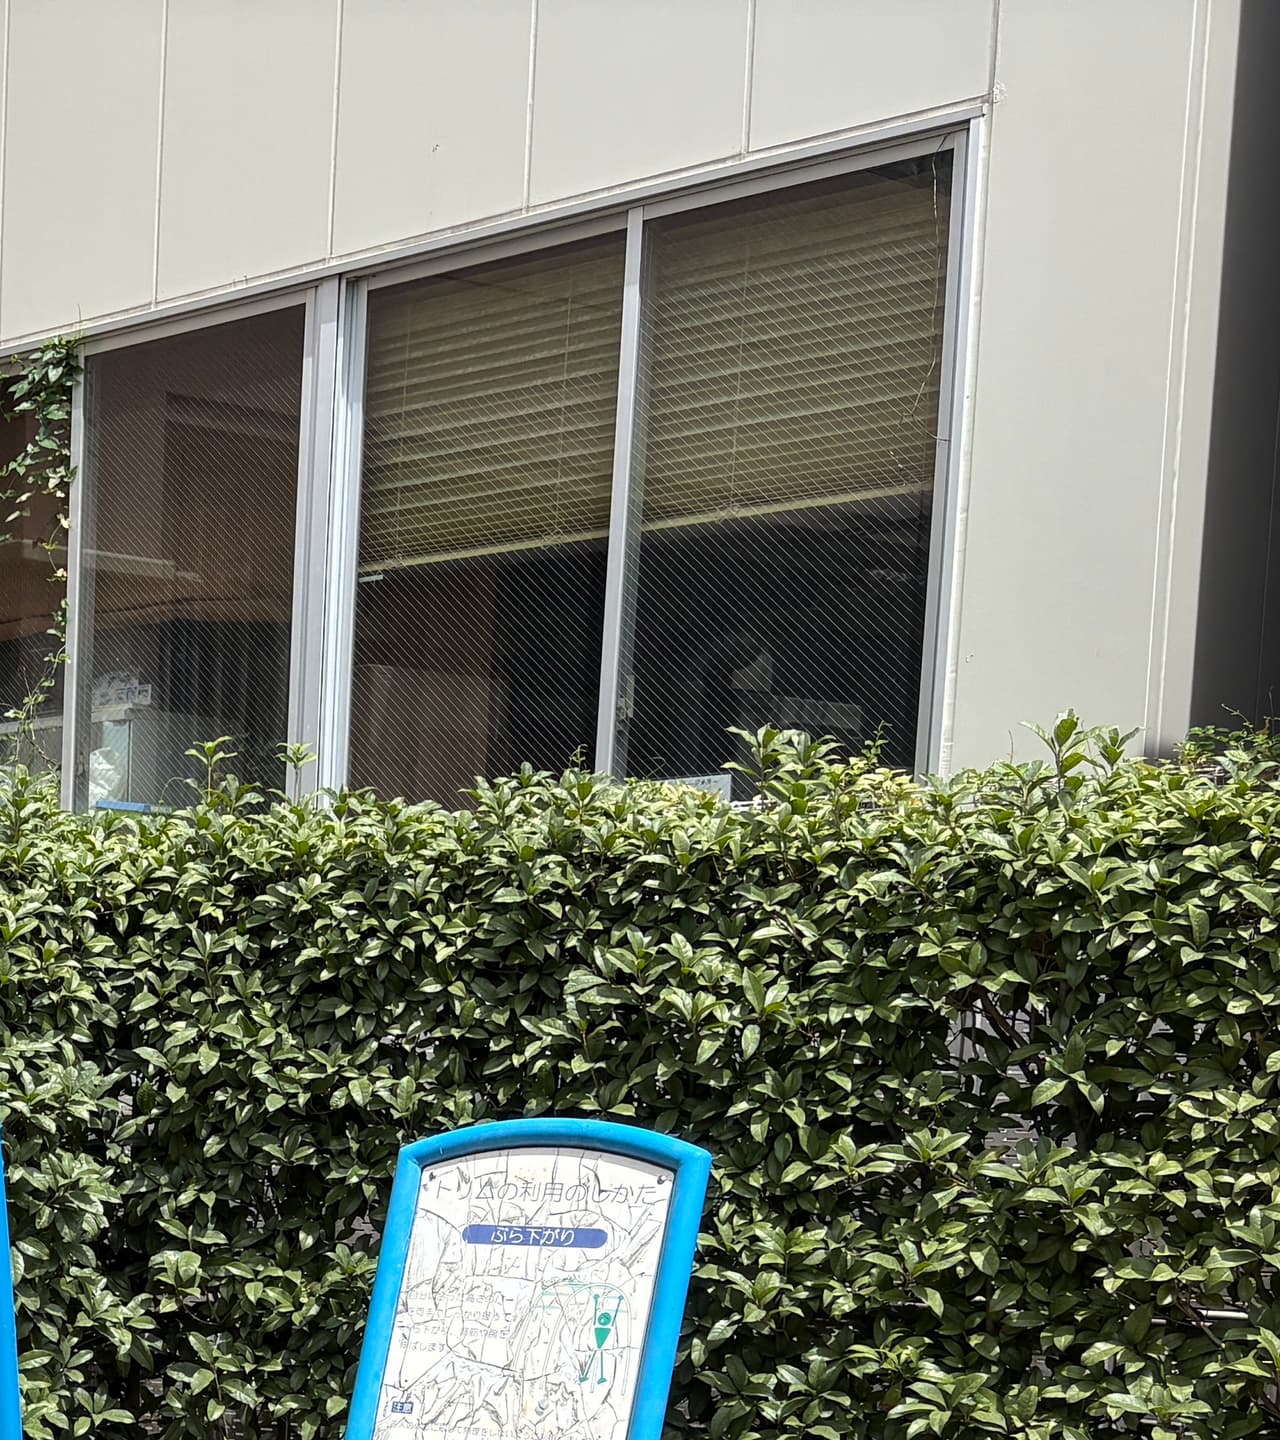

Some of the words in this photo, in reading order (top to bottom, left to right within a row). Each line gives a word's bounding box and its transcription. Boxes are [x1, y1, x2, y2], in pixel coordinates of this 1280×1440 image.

[436, 1178, 658, 1204] トリムの利用のしかた
[490, 1225, 575, 1246] ぶら下がり
